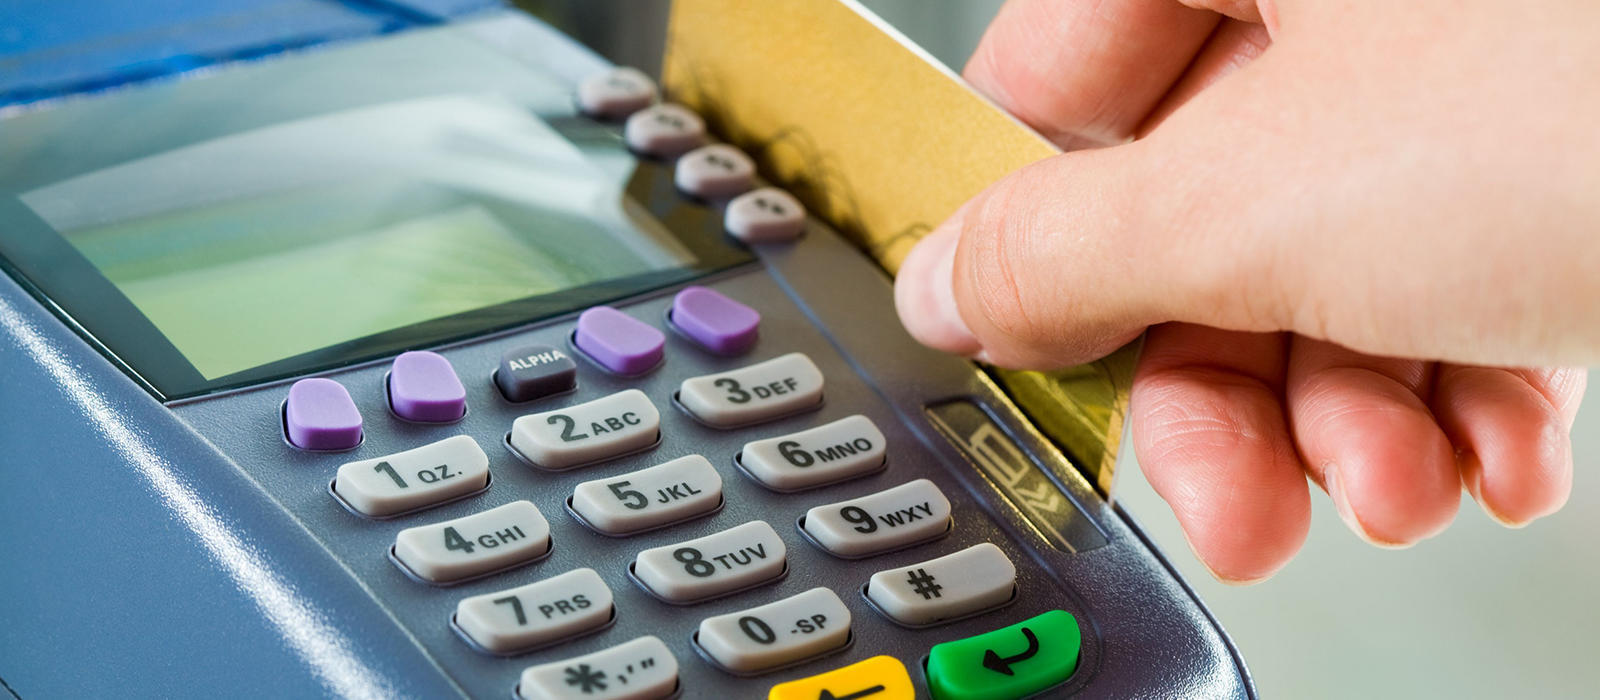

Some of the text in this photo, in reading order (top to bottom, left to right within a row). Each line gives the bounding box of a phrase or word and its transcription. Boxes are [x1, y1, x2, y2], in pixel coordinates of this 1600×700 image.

[509, 350, 566, 371] ALPHA
[714, 377, 799, 404] 3 DEF
[547, 411, 641, 442] 2 ABC
[777, 437, 872, 468] 6 MNO
[374, 461, 409, 488] 1
[607, 481, 702, 510] 5 JKL
[840, 502, 934, 534] 9 WXY
[444, 525, 527, 554] 4 GHI
[673, 543, 768, 578] 8 TUV
[907, 568, 943, 600] #
[493, 594, 592, 626] 7 PRS
[738, 616, 776, 644] 0
